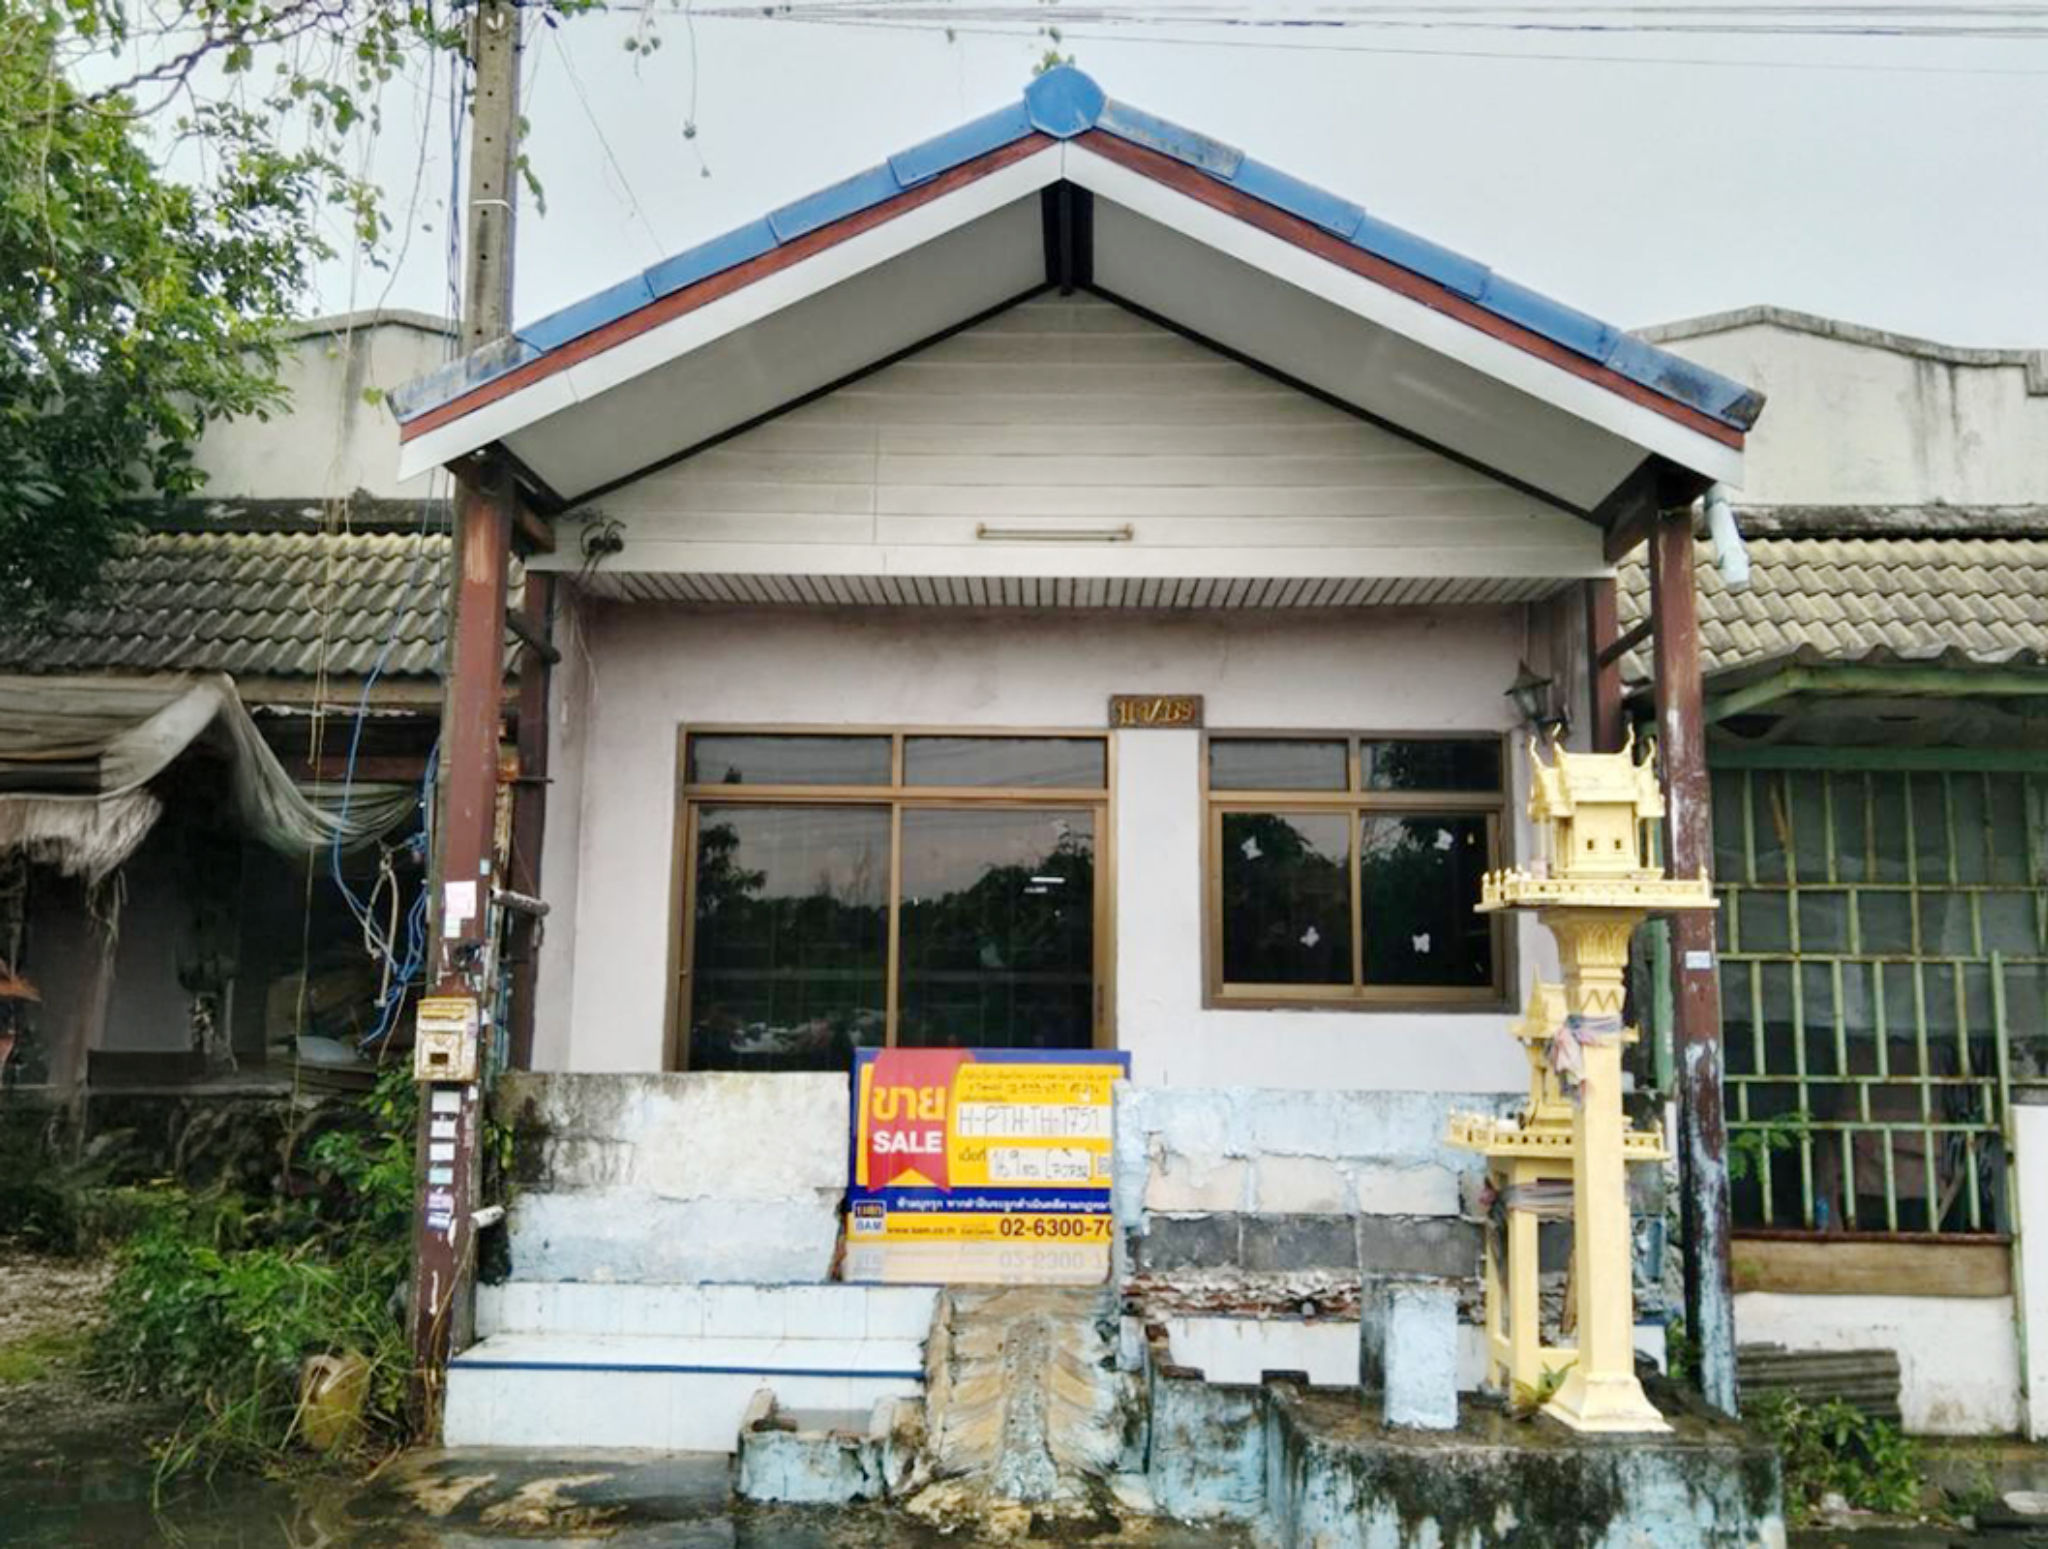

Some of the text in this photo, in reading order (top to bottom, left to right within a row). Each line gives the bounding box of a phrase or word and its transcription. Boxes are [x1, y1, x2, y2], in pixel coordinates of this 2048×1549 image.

[871, 1086, 946, 1121] ขาย
[872, 1130, 943, 1153] SALE
[855, 1219, 882, 1231] BAM
